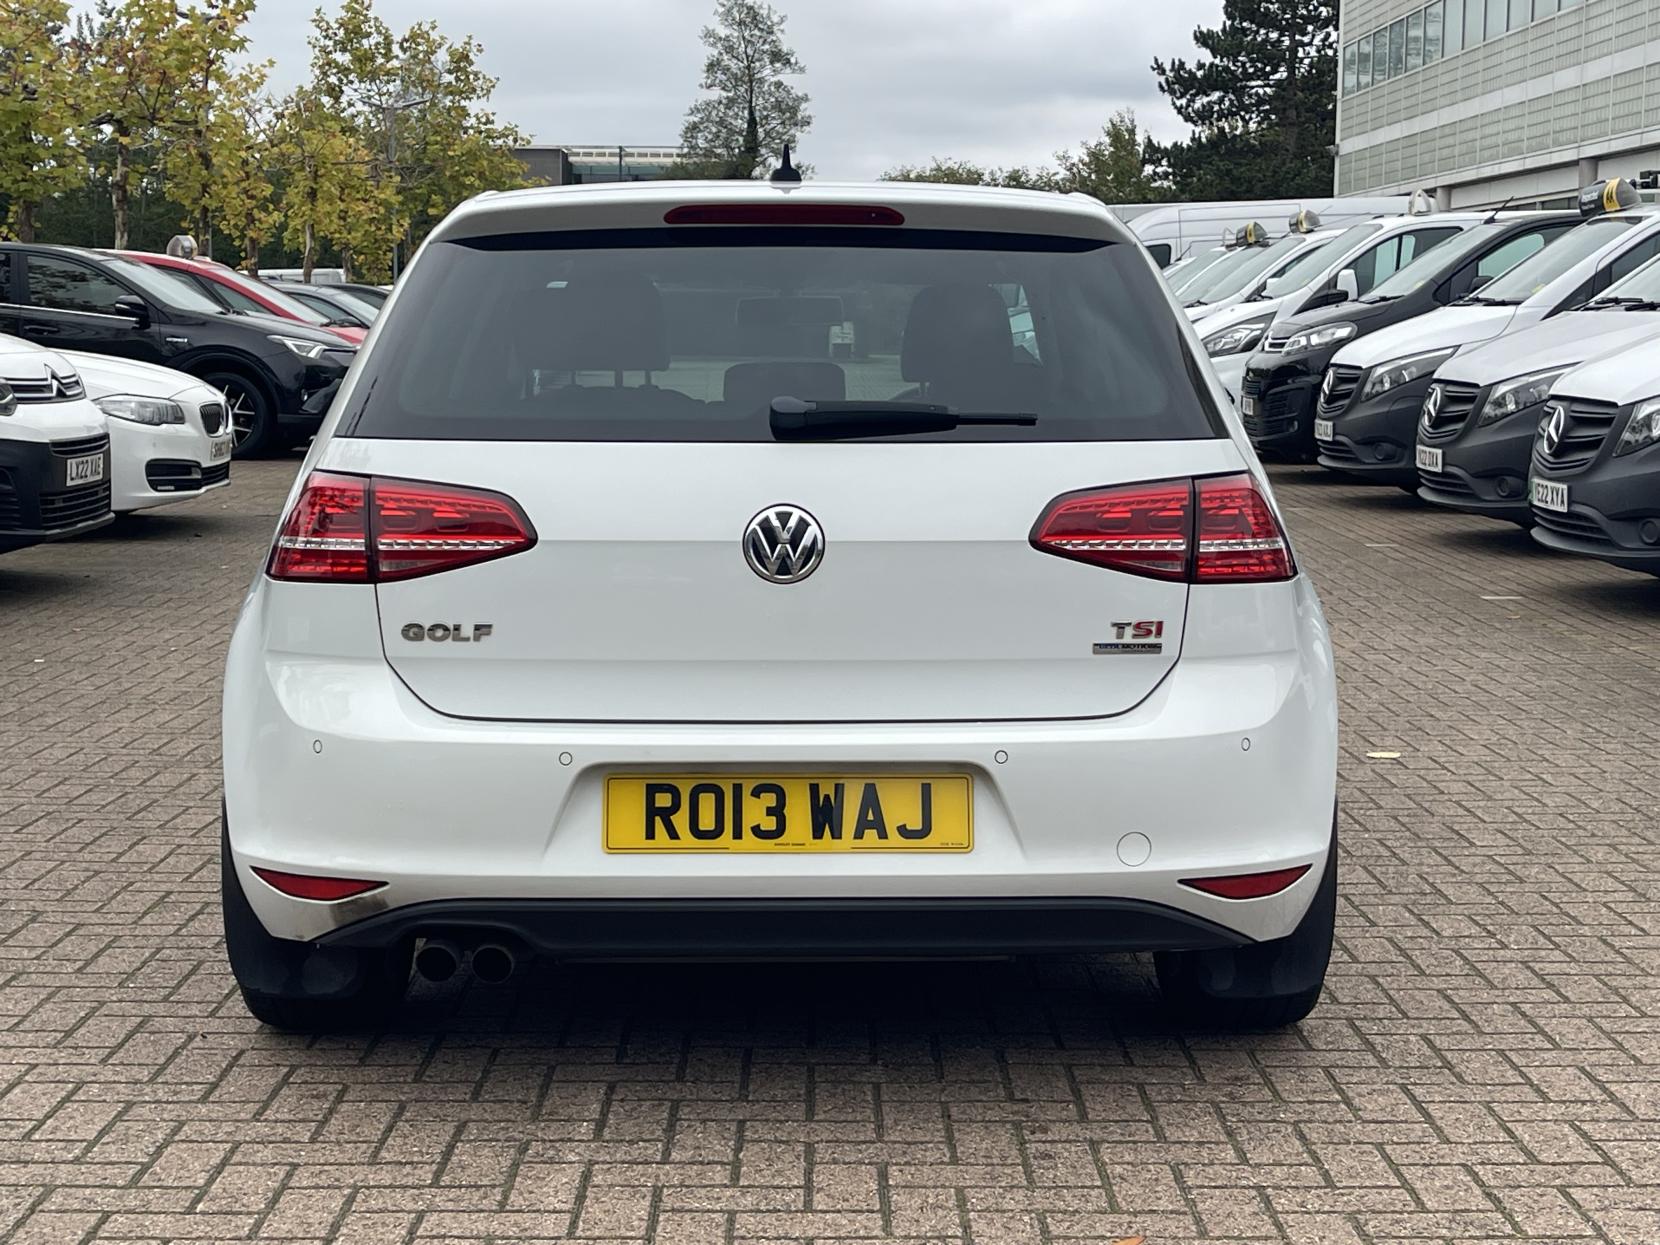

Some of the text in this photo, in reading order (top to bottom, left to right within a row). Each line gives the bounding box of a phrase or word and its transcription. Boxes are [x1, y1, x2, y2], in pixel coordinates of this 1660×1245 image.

[70, 460, 89, 481] LX22
[1550, 486, 1566, 508] XYA
[401, 623, 493, 642] GOLF
[1111, 621, 1164, 639] TSI
[644, 783, 932, 840] RO13 WAJ
